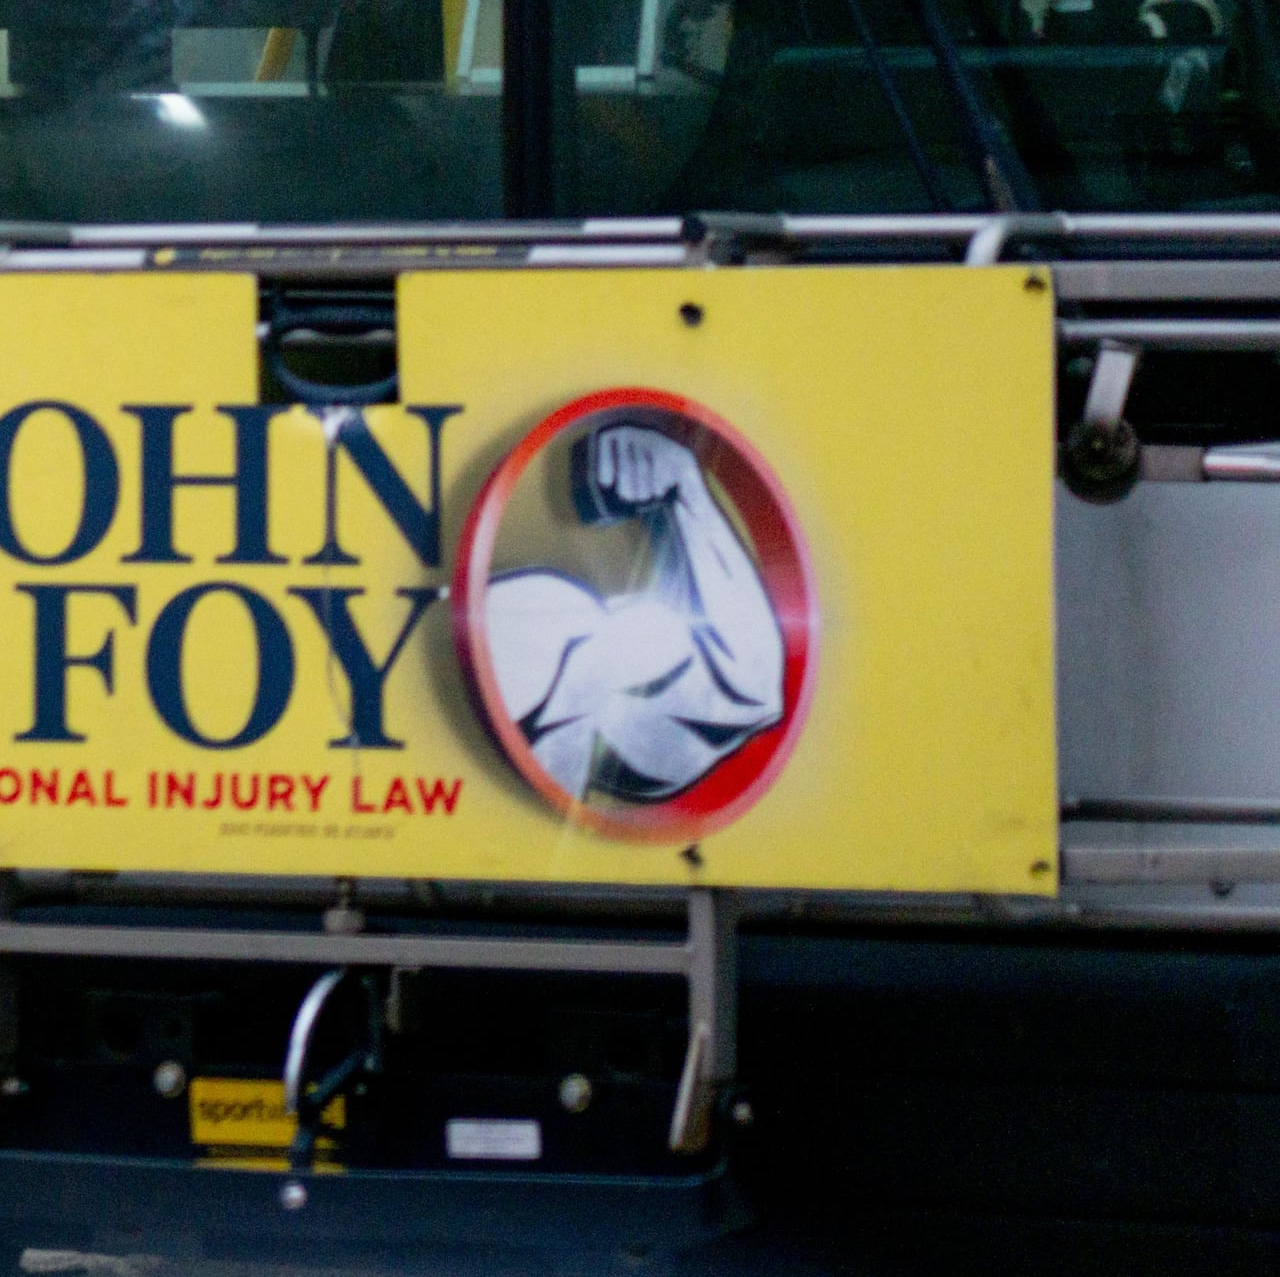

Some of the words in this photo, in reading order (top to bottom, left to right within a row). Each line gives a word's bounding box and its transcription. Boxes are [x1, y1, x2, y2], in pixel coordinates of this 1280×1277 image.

[12, 580, 442, 751] FOY
[147, 770, 331, 813] INJURY
[351, 777, 464, 816] LAW
